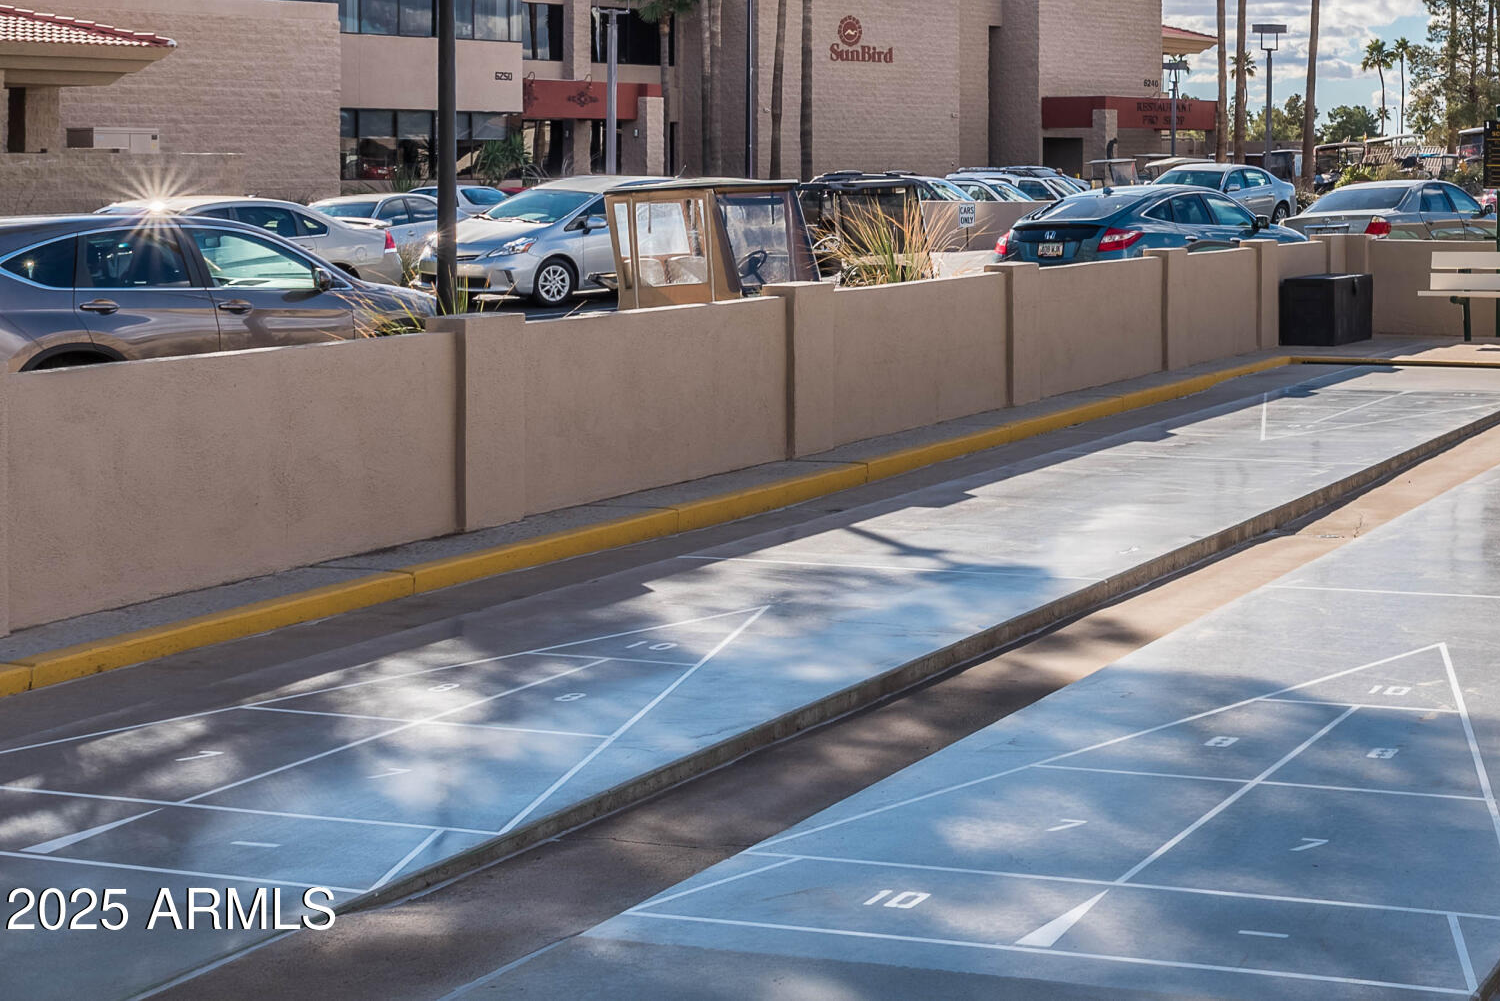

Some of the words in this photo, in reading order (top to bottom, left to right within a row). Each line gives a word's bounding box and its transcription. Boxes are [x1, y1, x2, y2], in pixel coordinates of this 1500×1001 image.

[829, 43, 893, 63] SunBird
[1144, 79, 1158, 87] 6240
[960, 206, 974, 215] CARS
[960, 216, 974, 225] ONLY
[625, 640, 678, 651] 10
[428, 682, 460, 692] 8
[1368, 685, 1412, 696] 10
[553, 692, 587, 702] 8
[1203, 735, 1240, 748] 8
[1366, 748, 1400, 759] 8
[1044, 818, 1088, 831] 7
[1289, 837, 1329, 851] 7
[862, 889, 932, 909] 10
